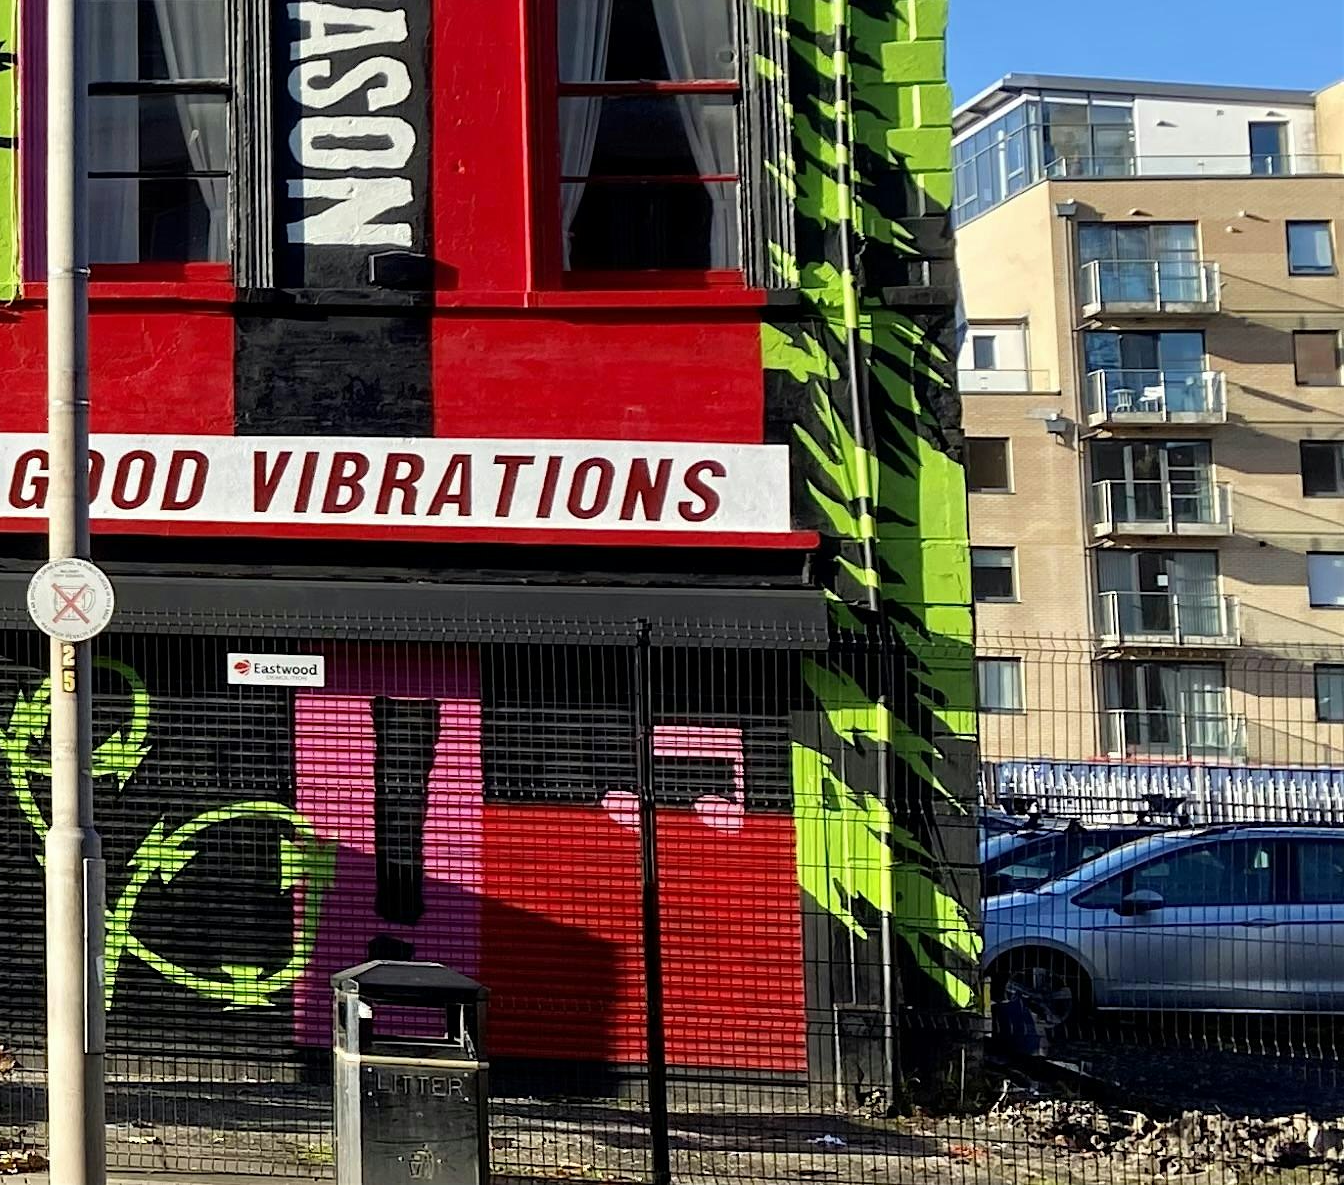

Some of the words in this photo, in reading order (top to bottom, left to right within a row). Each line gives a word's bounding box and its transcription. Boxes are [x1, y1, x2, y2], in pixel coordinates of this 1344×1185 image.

[253, 451, 728, 523] VIBRATIONS
[254, 662, 318, 676] Eastwood
[376, 1072, 463, 1097] LITTER
